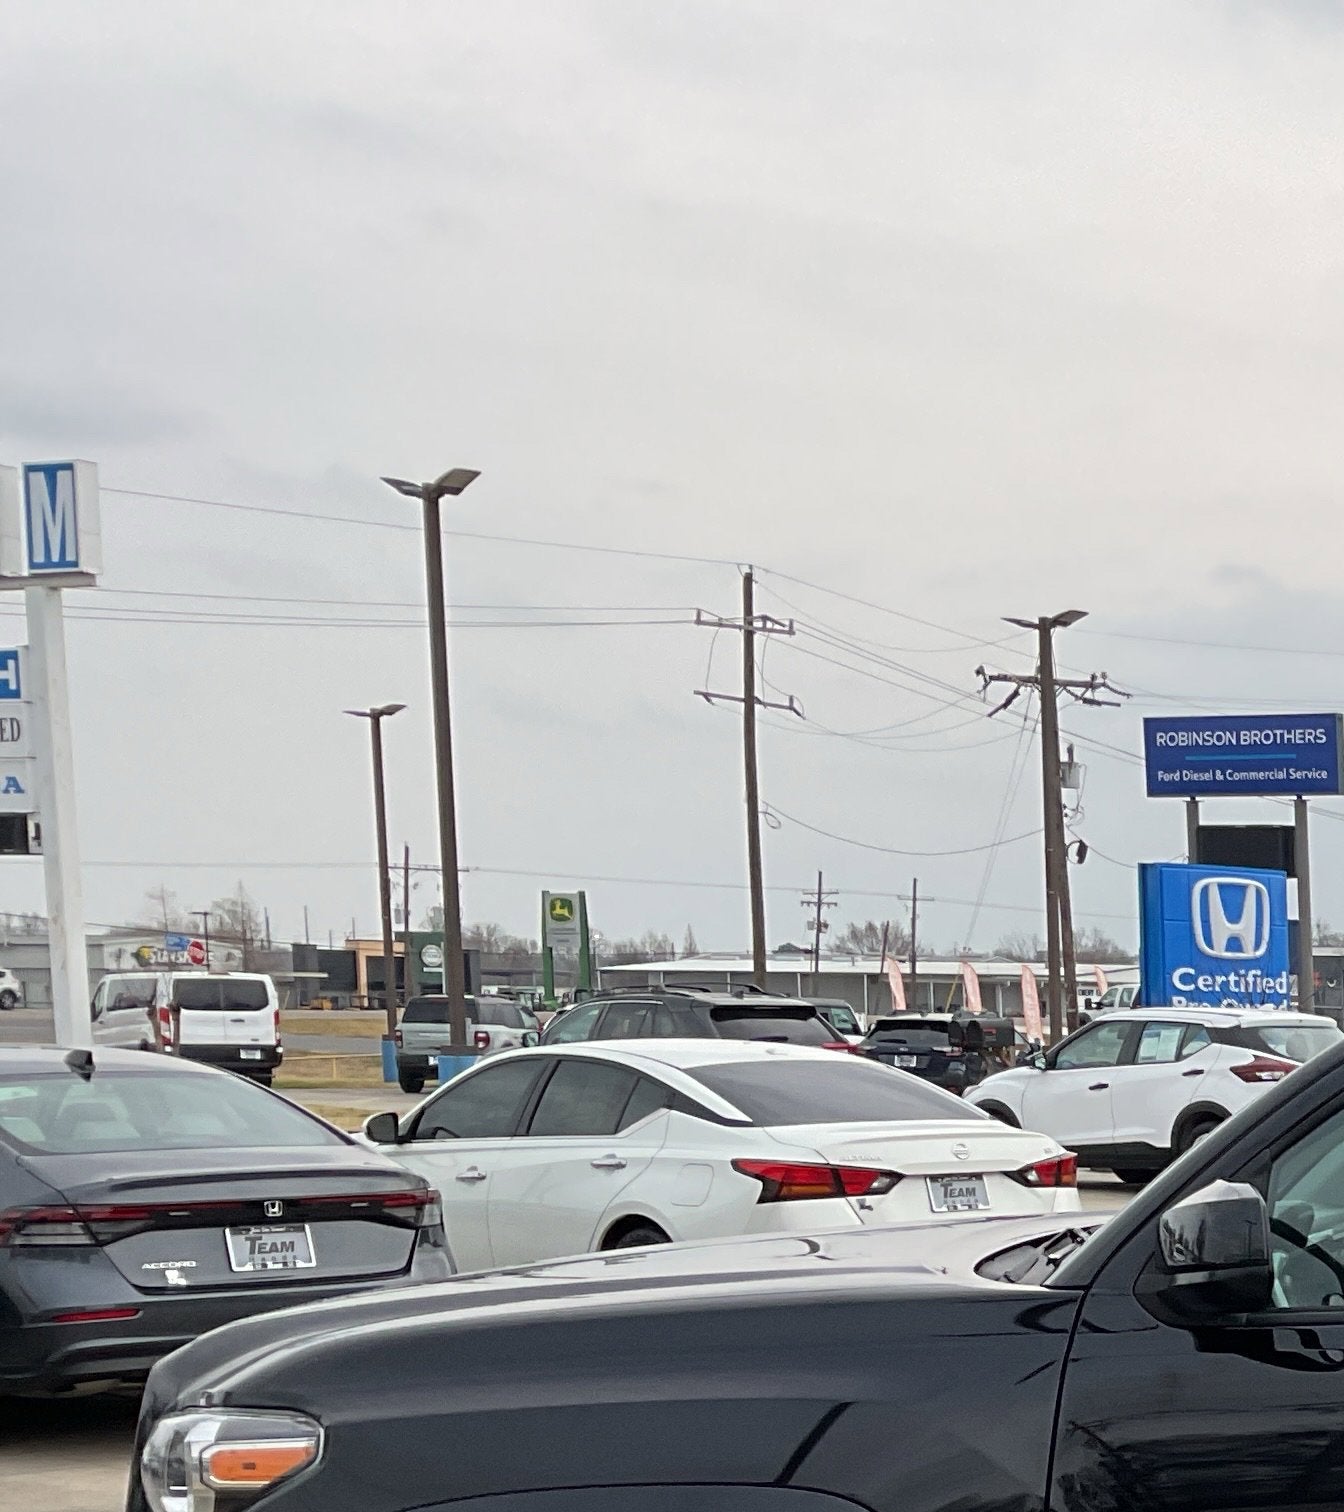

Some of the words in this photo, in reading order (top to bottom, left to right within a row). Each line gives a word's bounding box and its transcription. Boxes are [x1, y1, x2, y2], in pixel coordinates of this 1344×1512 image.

[29, 469, 77, 563] M
[1156, 731, 1237, 747] ROBINSON
[1240, 729, 1327, 745] BROTHERS
[1157, 770, 1180, 782] Ford
[1182, 769, 1213, 781] Diesel
[1216, 769, 1224, 781] &
[1226, 768, 1286, 780] Commercial
[1289, 768, 1328, 780] Service
[1171, 967, 1287, 994] Certified
[940, 1182, 976, 1199] TEAM
[244, 1236, 295, 1255] TEAM
